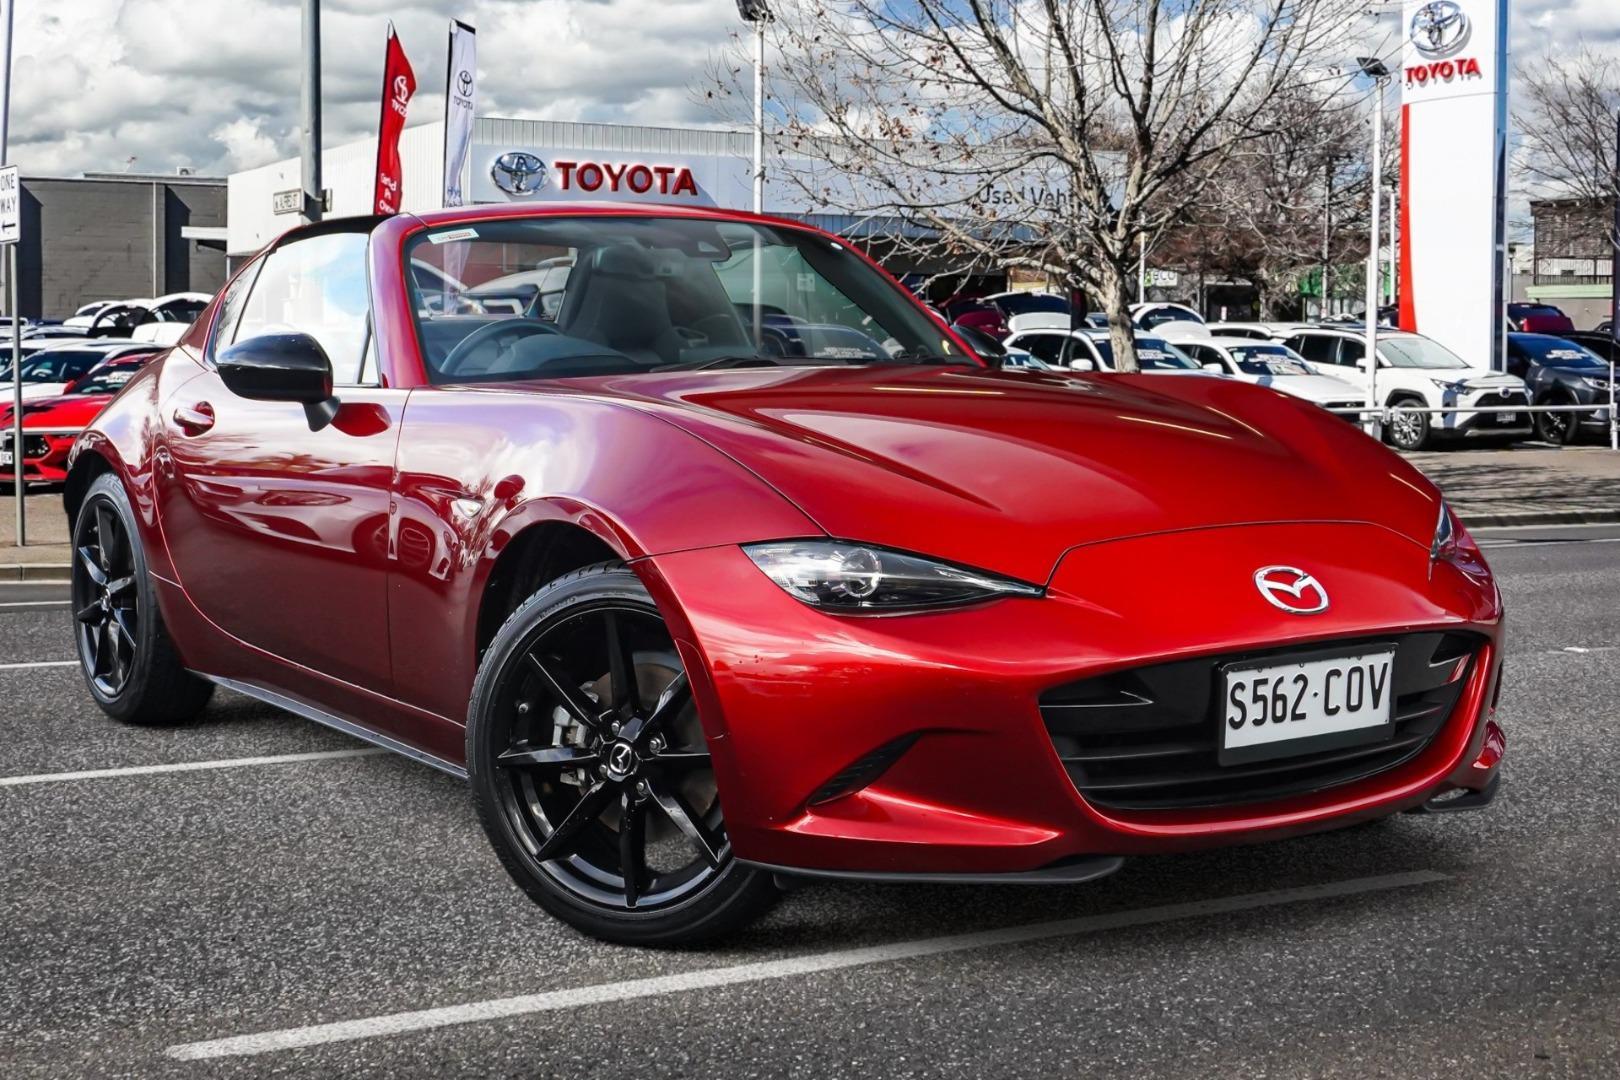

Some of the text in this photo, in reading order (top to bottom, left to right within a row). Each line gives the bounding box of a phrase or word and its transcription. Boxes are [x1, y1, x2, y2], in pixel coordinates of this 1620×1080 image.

[1405, 58, 1481, 83] TOYOTA
[1, 173, 15, 191] ONE
[554, 161, 698, 196] TOYOTA
[0, 196, 16, 213] WAY
[978, 186, 1025, 205] Used
